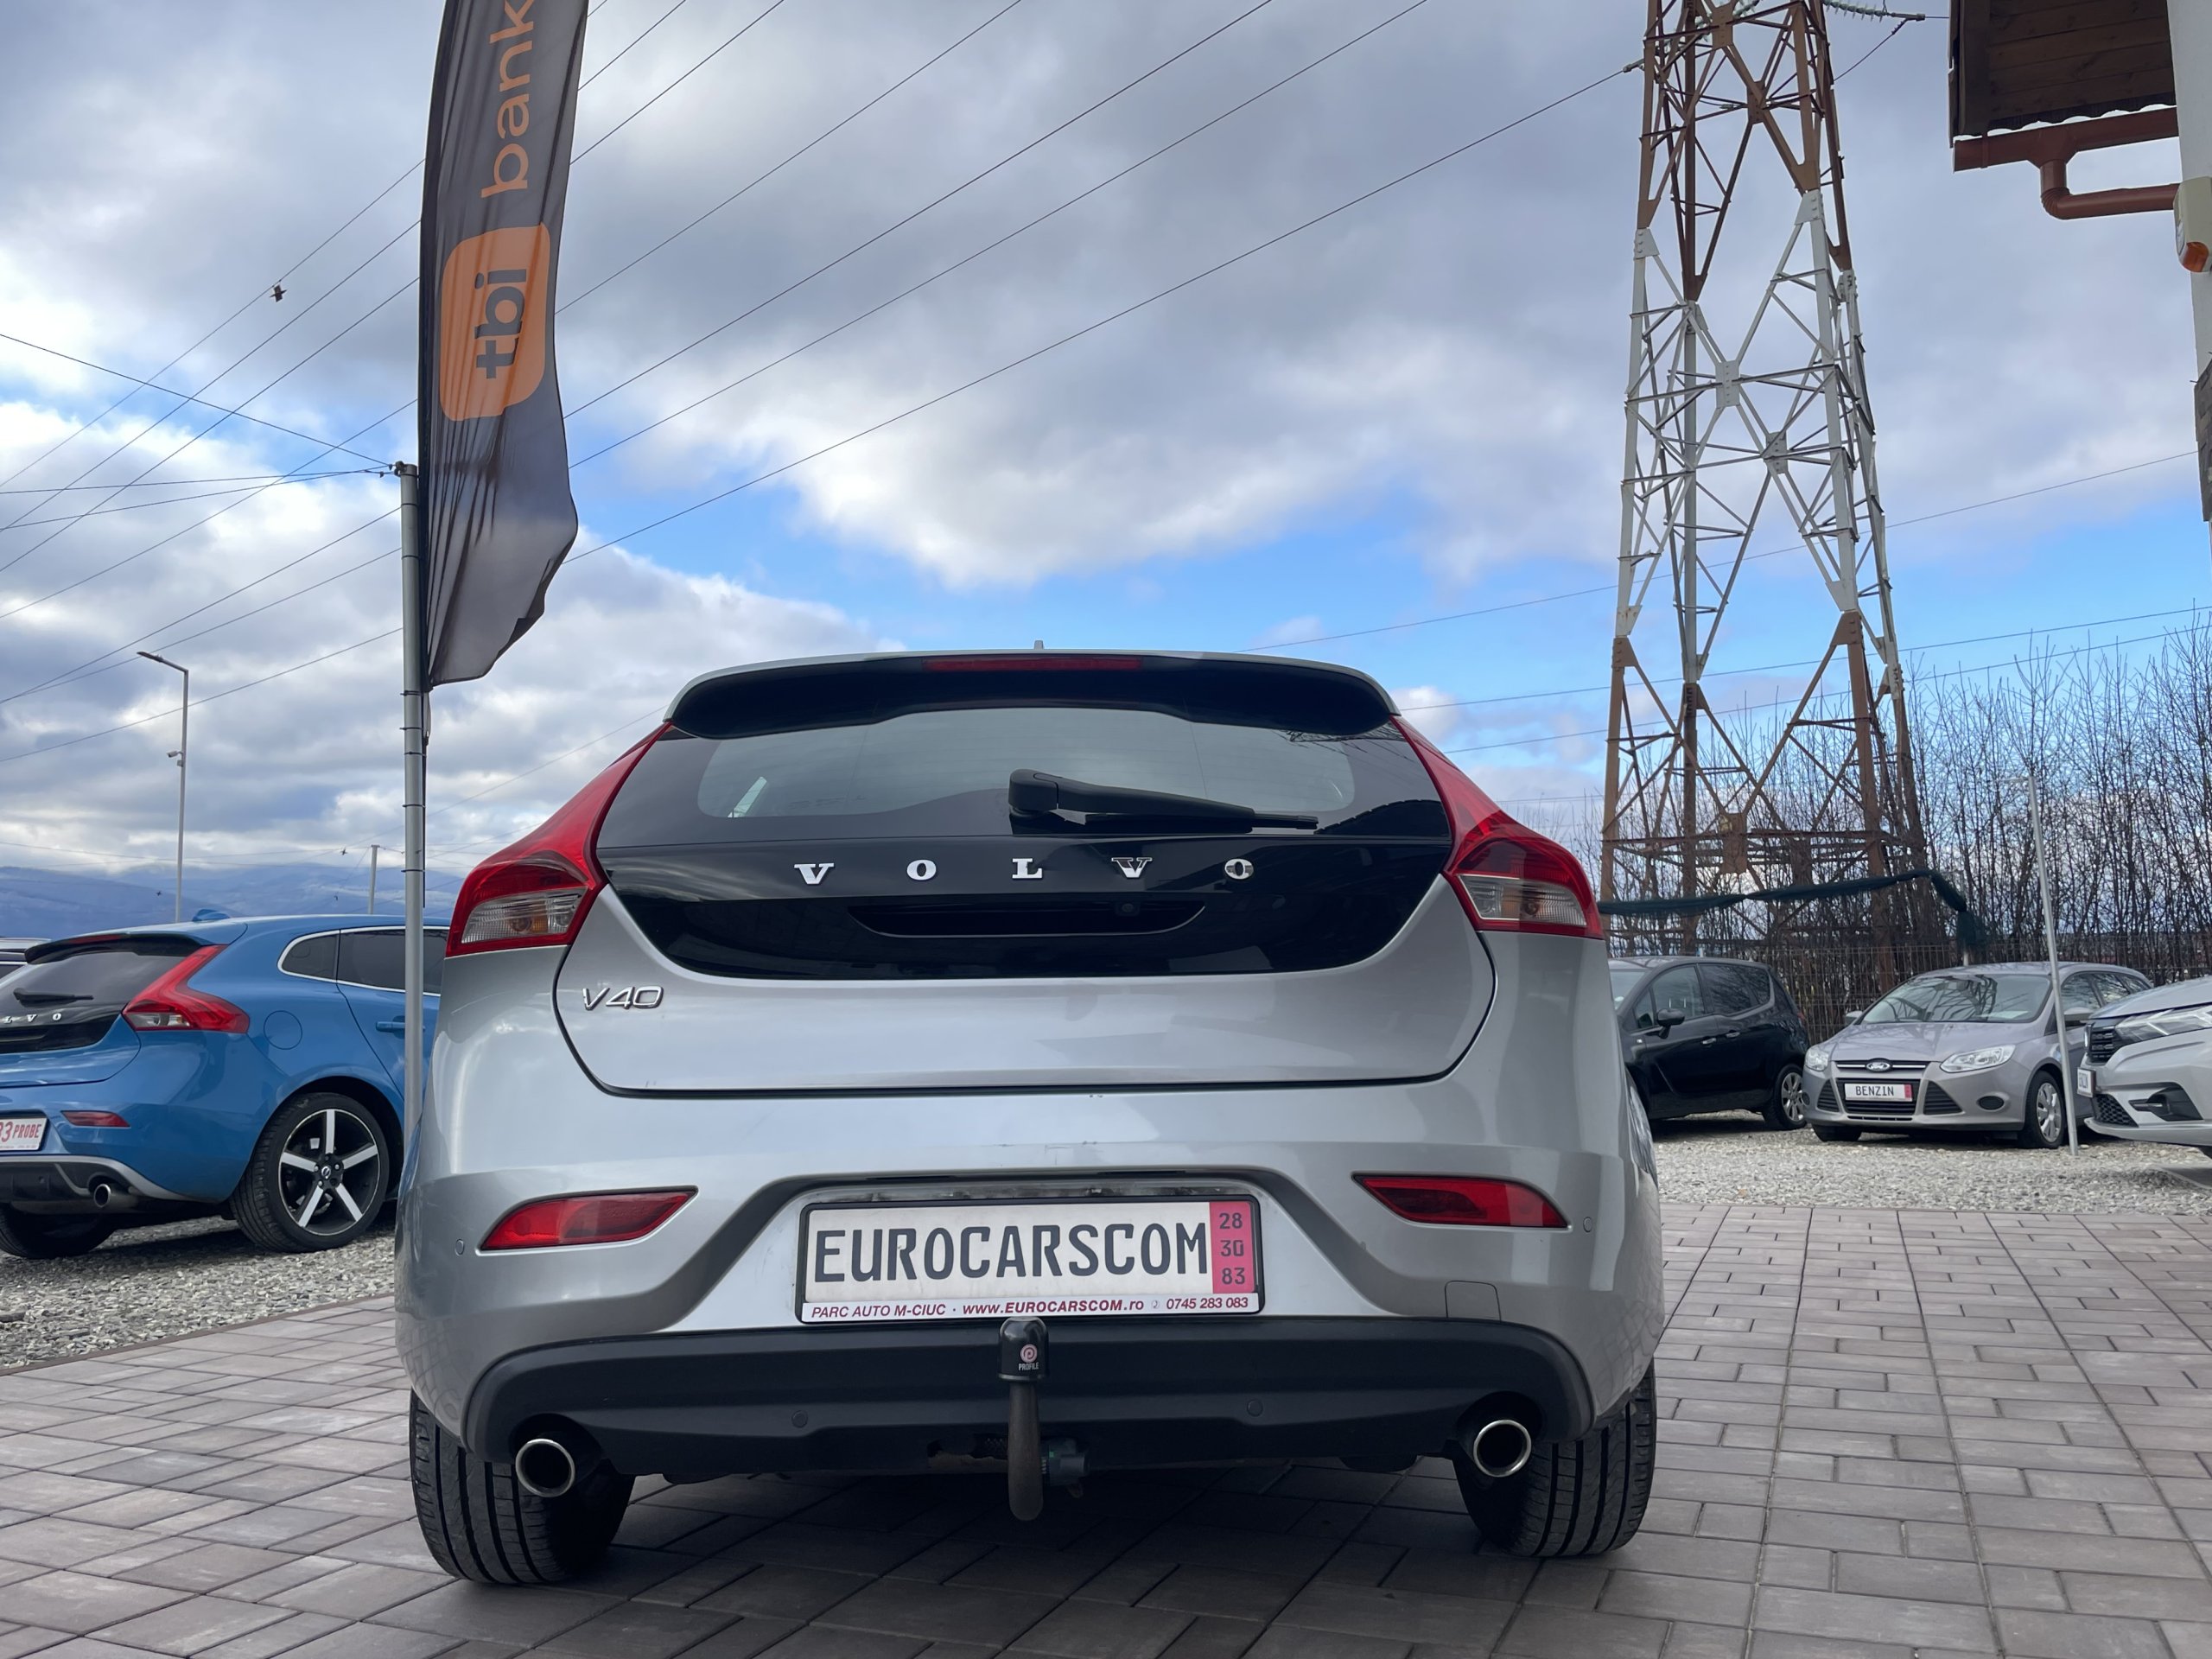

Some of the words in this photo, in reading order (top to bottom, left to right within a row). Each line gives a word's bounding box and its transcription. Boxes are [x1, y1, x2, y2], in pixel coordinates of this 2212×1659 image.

[480, 0, 535, 199] bank
[474, 269, 527, 379] tbi
[794, 856, 1255, 886] VOLVO
[582, 985, 664, 1011] V40
[1855, 1085, 1895, 1096] BENZIN
[12, 1123, 42, 1139] PROBE
[1218, 1212, 1243, 1230] 28
[814, 1222, 1208, 1283] EUROCARSCOM
[1220, 1239, 1244, 1256] 30
[1221, 1267, 1246, 1285] 83
[811, 1306, 849, 1318] PARC
[852, 1305, 891, 1318] AUTO
[893, 1303, 946, 1317] M-CIUC
[1166, 1299, 1197, 1310] 0745
[1199, 1298, 1223, 1309] 283
[1225, 1297, 1249, 1308] 083
[1018, 1362, 1039, 1371] PROFILE
